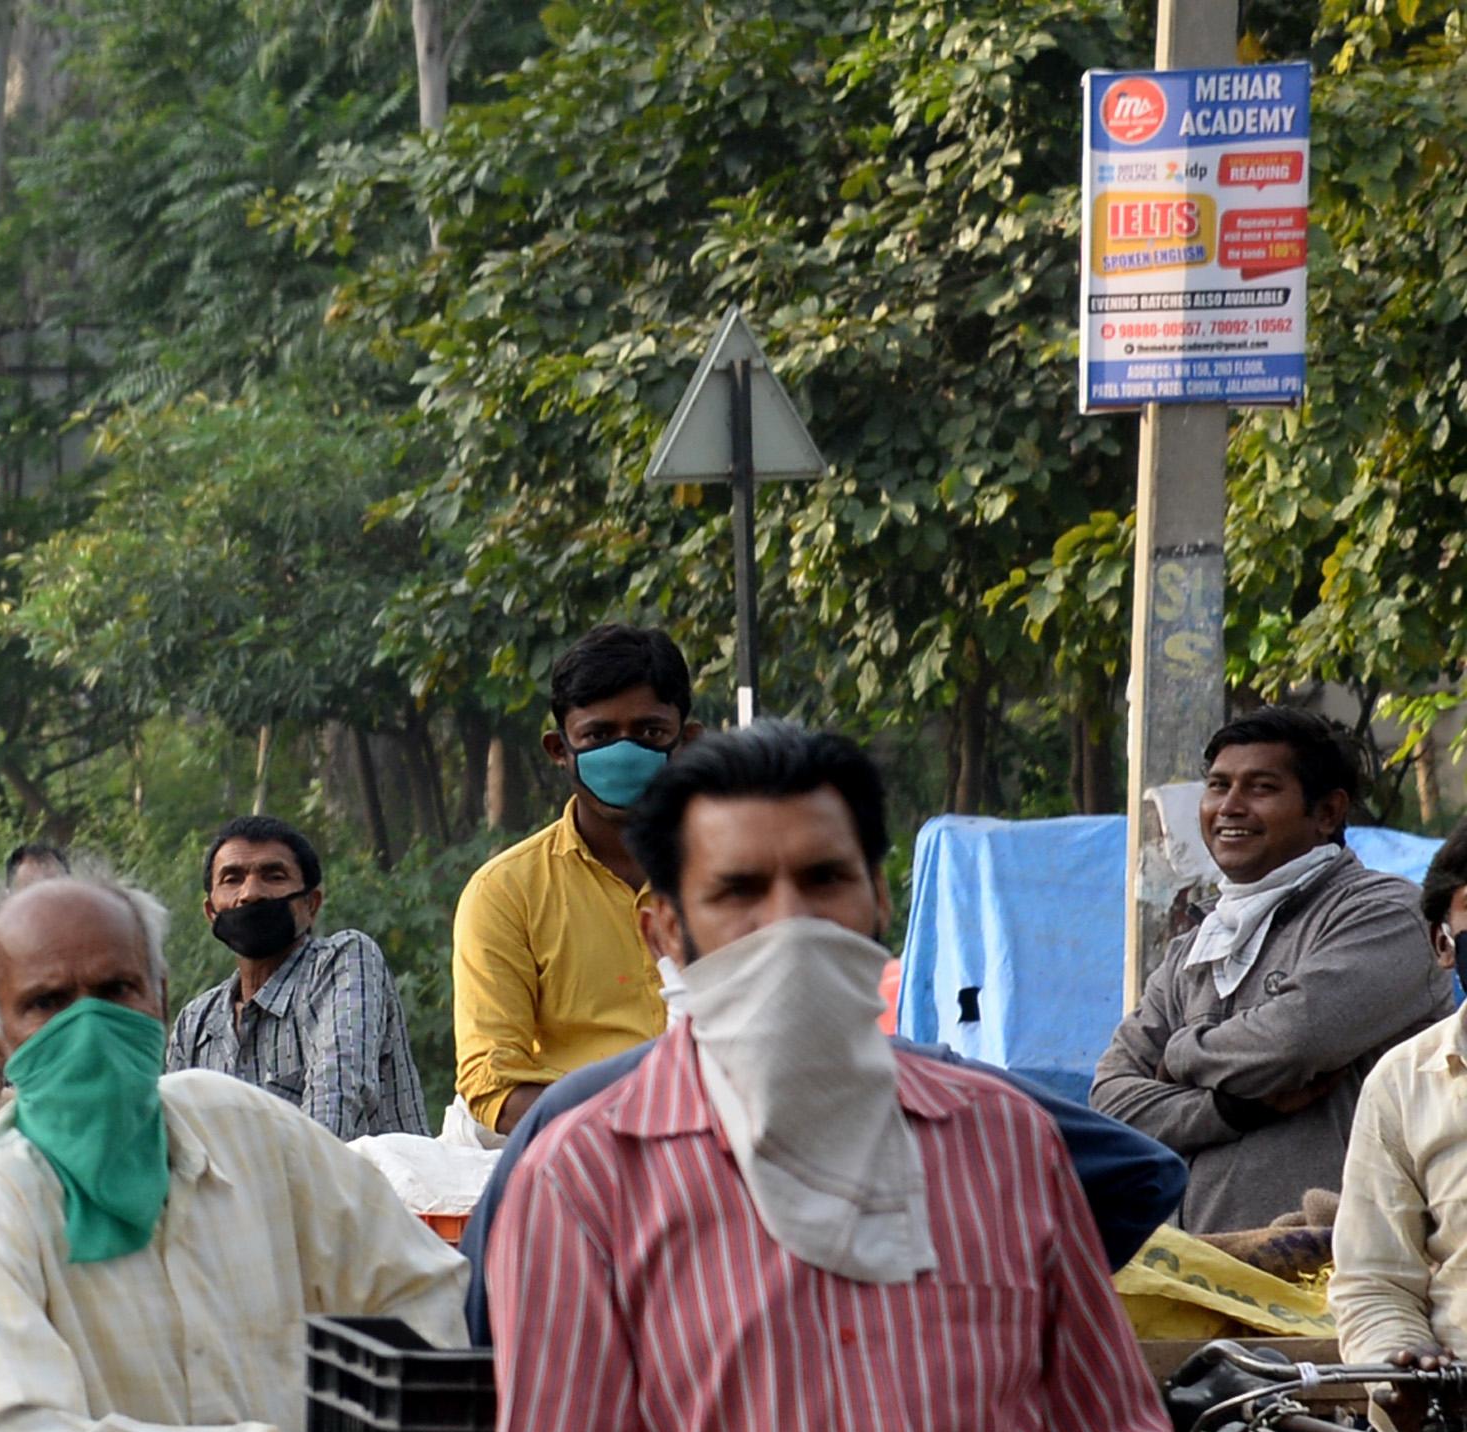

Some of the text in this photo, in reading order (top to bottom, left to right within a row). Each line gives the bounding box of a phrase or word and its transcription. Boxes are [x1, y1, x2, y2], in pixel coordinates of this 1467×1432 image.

[1195, 72, 1282, 102] MEHAR
[1179, 105, 1296, 136] ACADEMY
[1185, 161, 1208, 181] idp
[1229, 165, 1291, 181] READING
[1108, 200, 1198, 239] IELTS
[1103, 245, 1205, 271] SPOKEN ENGLISH
[1090, 288, 1285, 312] EVENING BATCHES ALSO AVAILABLE
